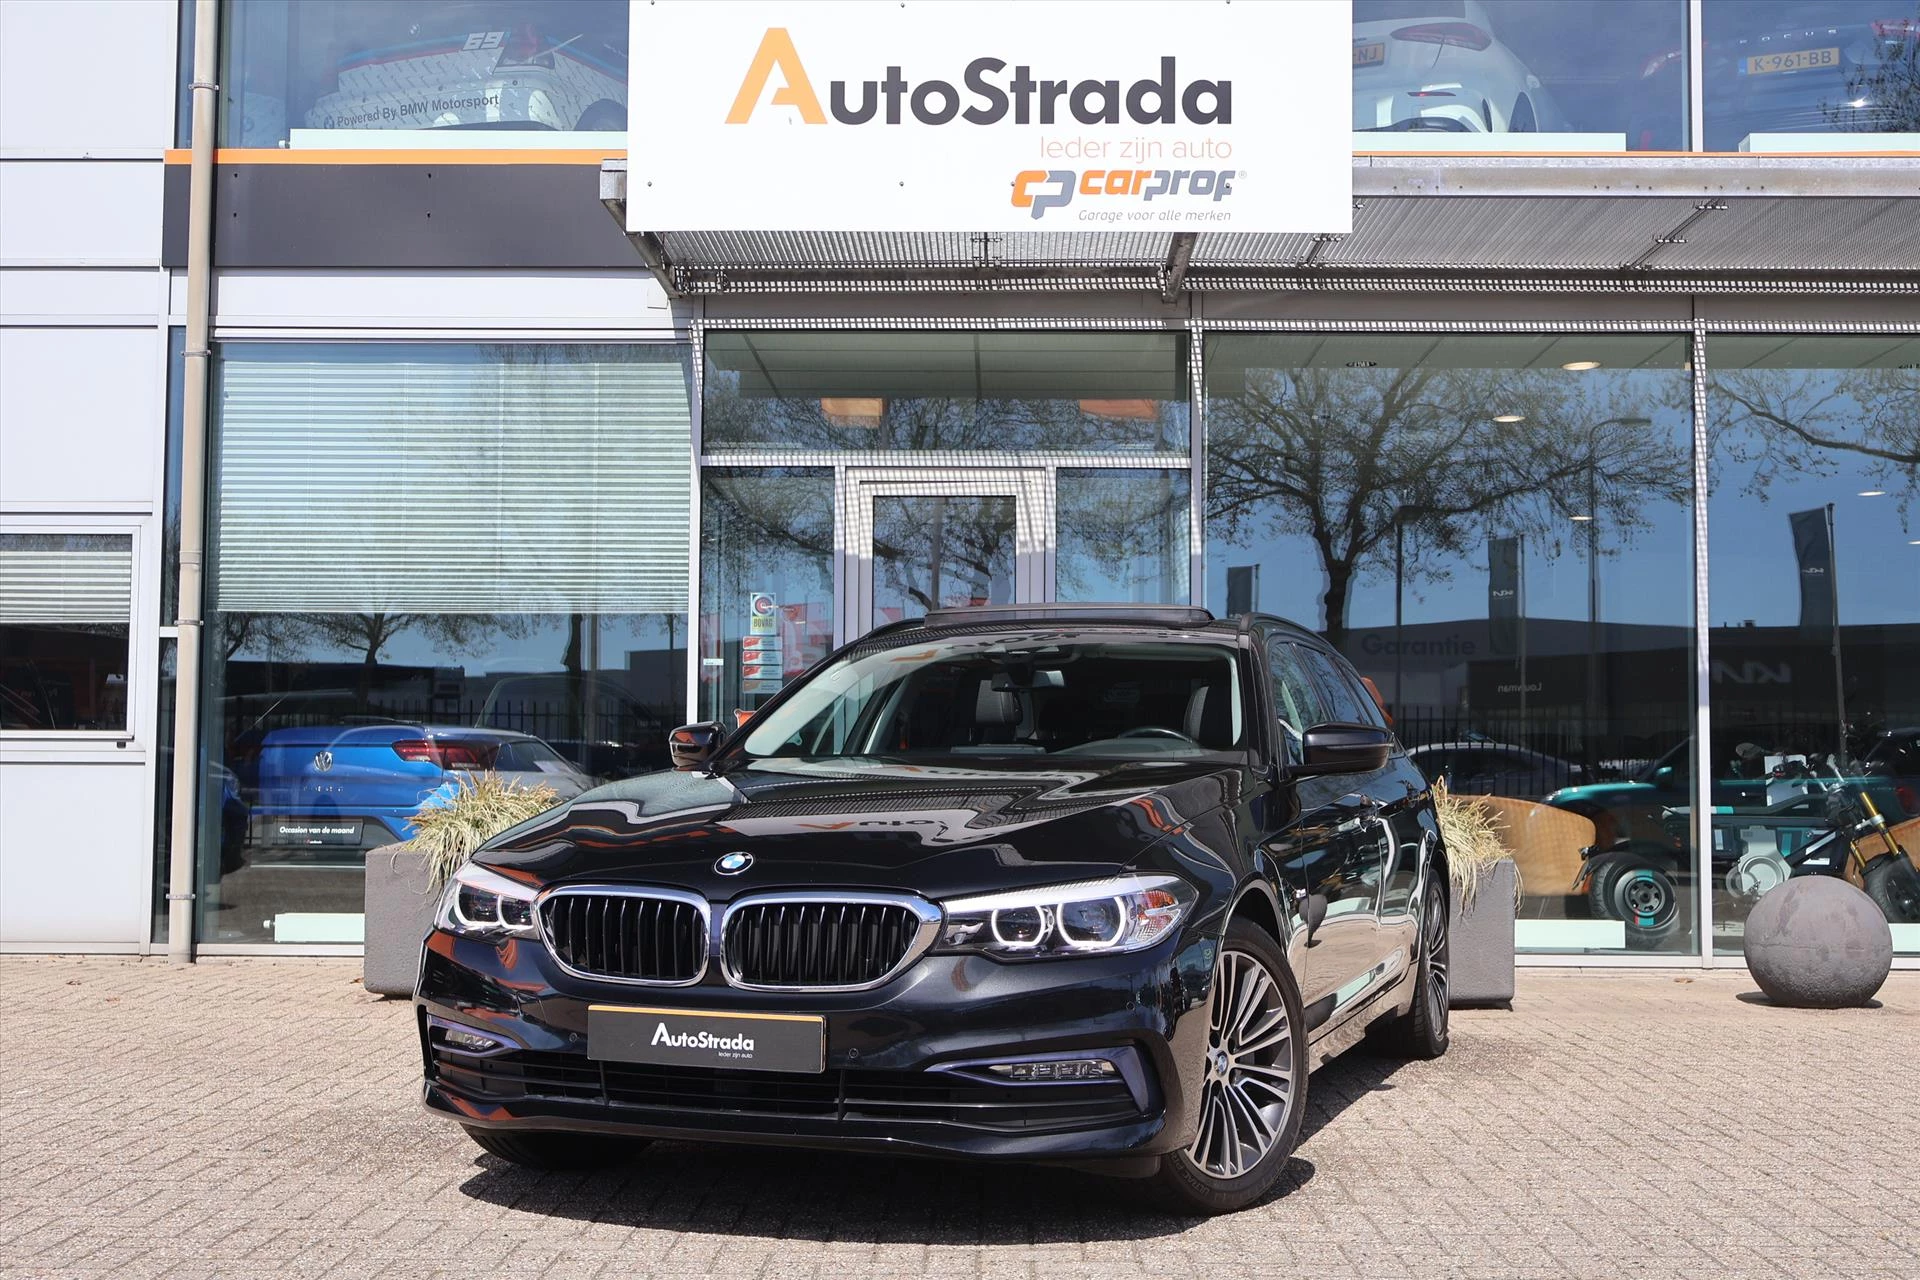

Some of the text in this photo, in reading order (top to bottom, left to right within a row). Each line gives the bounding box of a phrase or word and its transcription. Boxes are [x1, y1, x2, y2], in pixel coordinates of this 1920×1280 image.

[462, 31, 504, 51] 69
[1753, 50, 1832, 72] K-961-BB
[724, 27, 1232, 125] AutoStrada
[336, 93, 500, 128] Powered By BMW Motorsport
[1041, 136, 1232, 164] Ieder zijn auto
[1079, 170, 1236, 201] carprof
[1078, 209, 1232, 223] Garage voor alle merken
[1361, 633, 1477, 656] Garantie
[279, 826, 308, 834] Occasion
[321, 826, 331, 834] de
[331, 826, 355, 834] maand
[651, 1022, 755, 1051] AutoStrada
